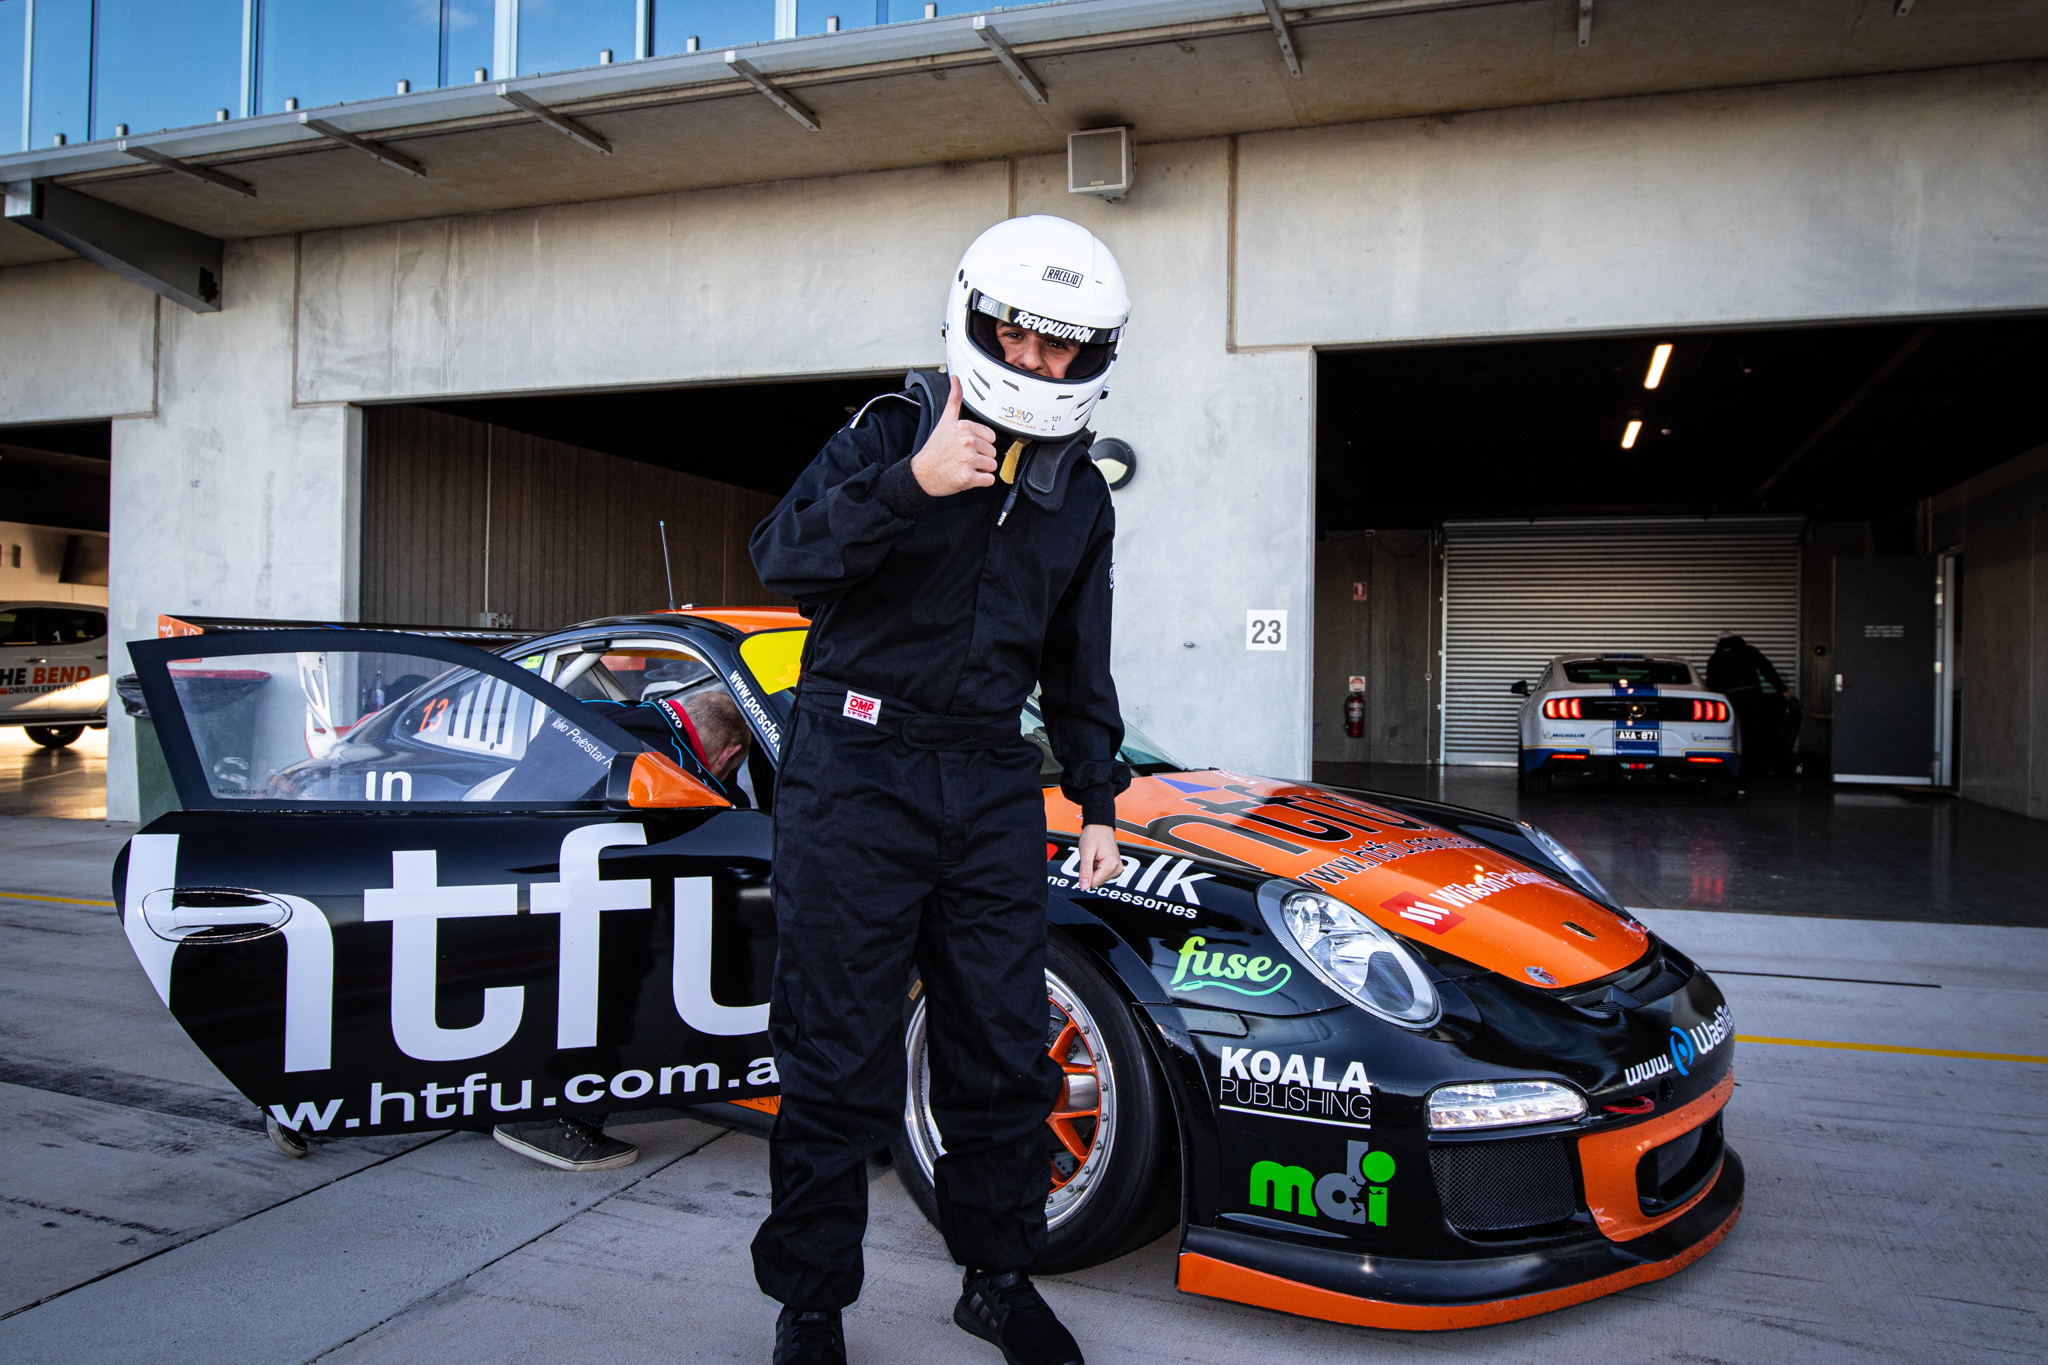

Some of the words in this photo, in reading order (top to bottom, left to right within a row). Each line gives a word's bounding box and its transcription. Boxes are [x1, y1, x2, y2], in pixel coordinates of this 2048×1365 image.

[1013, 310, 1096, 343] REVOLUTION
[1251, 619, 1282, 645] 23
[8, 685, 40, 695] DRIVER
[32, 666, 91, 685] BEND
[418, 698, 449, 732] 13
[657, 698, 683, 729] VOLVO
[847, 709, 872, 721] SPORT
[849, 698, 875, 713] OMP
[565, 728, 607, 762] Polestar
[123, 822, 772, 1073] htfu
[1170, 936, 1290, 990] fuse
[1220, 1045, 1372, 1096] KOALA
[1220, 1078, 1372, 1121] PUBLISHING
[1249, 1139, 1396, 1227] mdi
